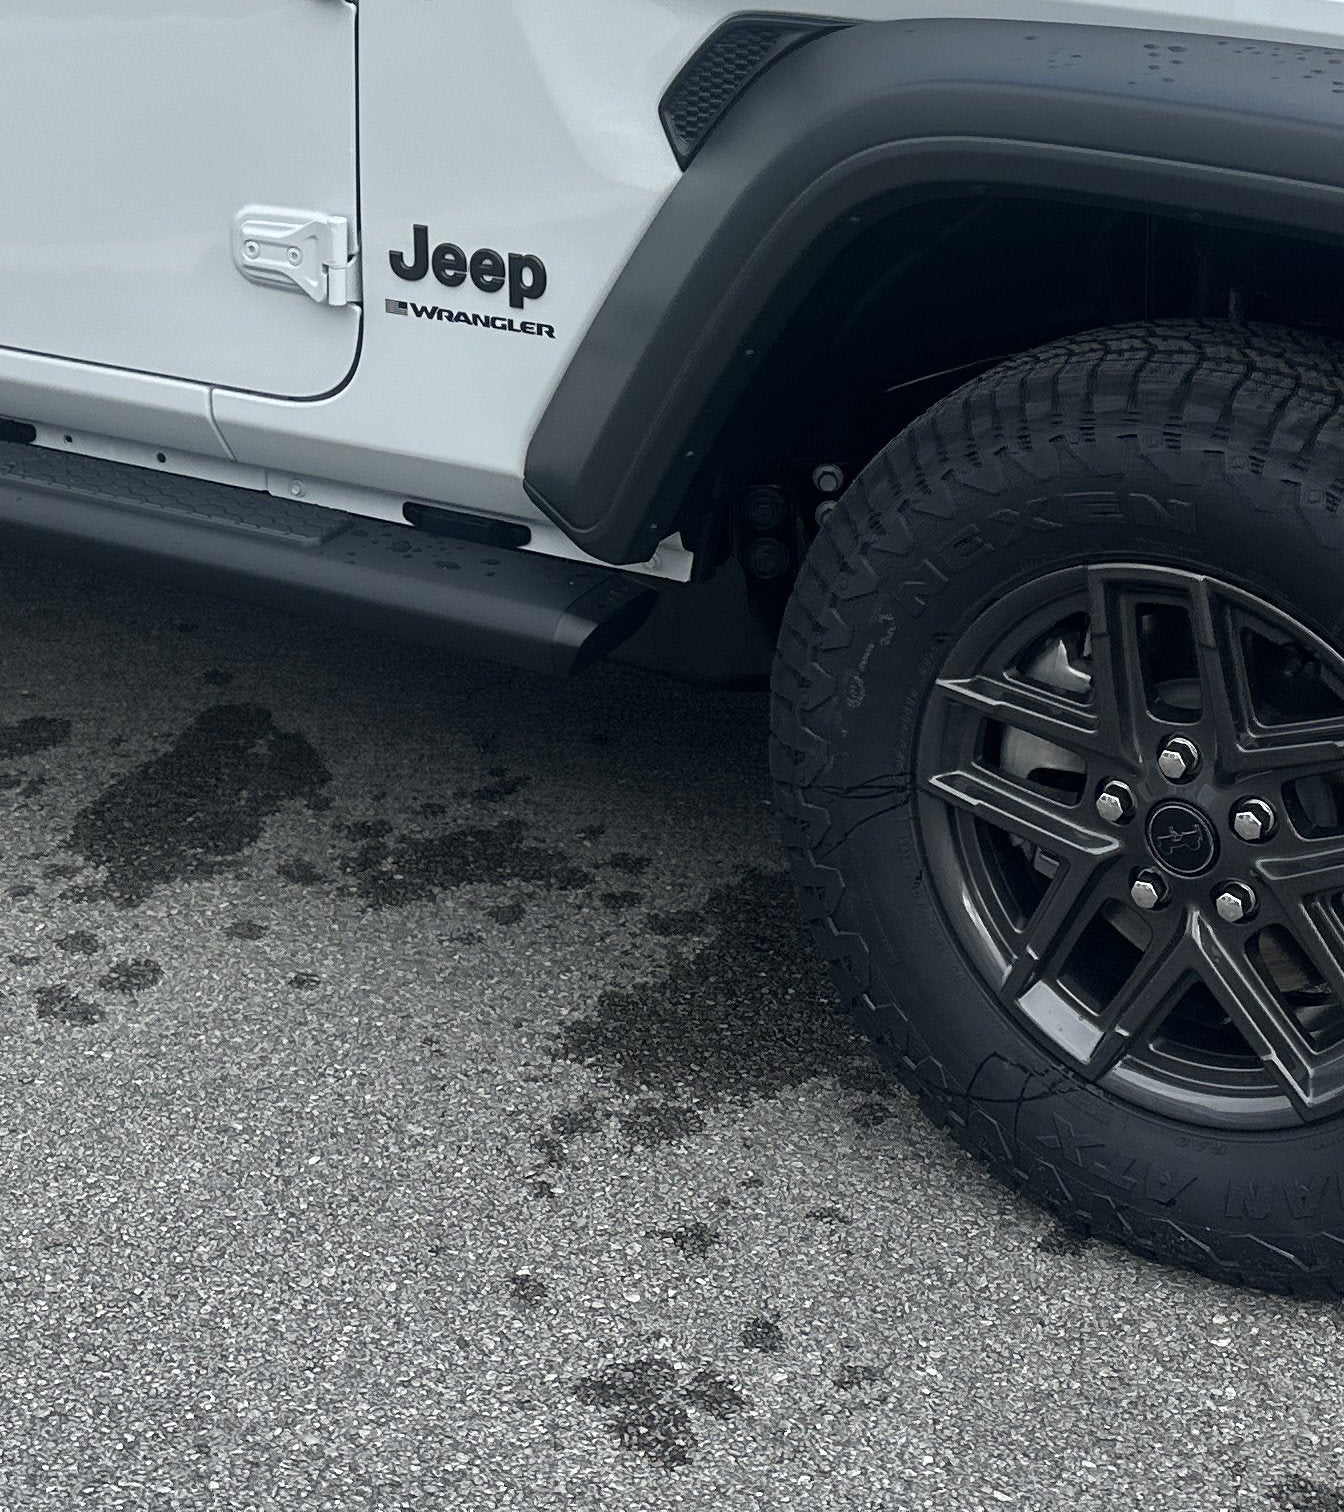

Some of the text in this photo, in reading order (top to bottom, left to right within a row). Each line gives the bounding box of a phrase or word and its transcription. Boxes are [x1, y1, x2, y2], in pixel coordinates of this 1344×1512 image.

[388, 224, 547, 309] Jeep
[410, 302, 556, 339] WRANGLER
[898, 490, 1198, 618] NEXEN
